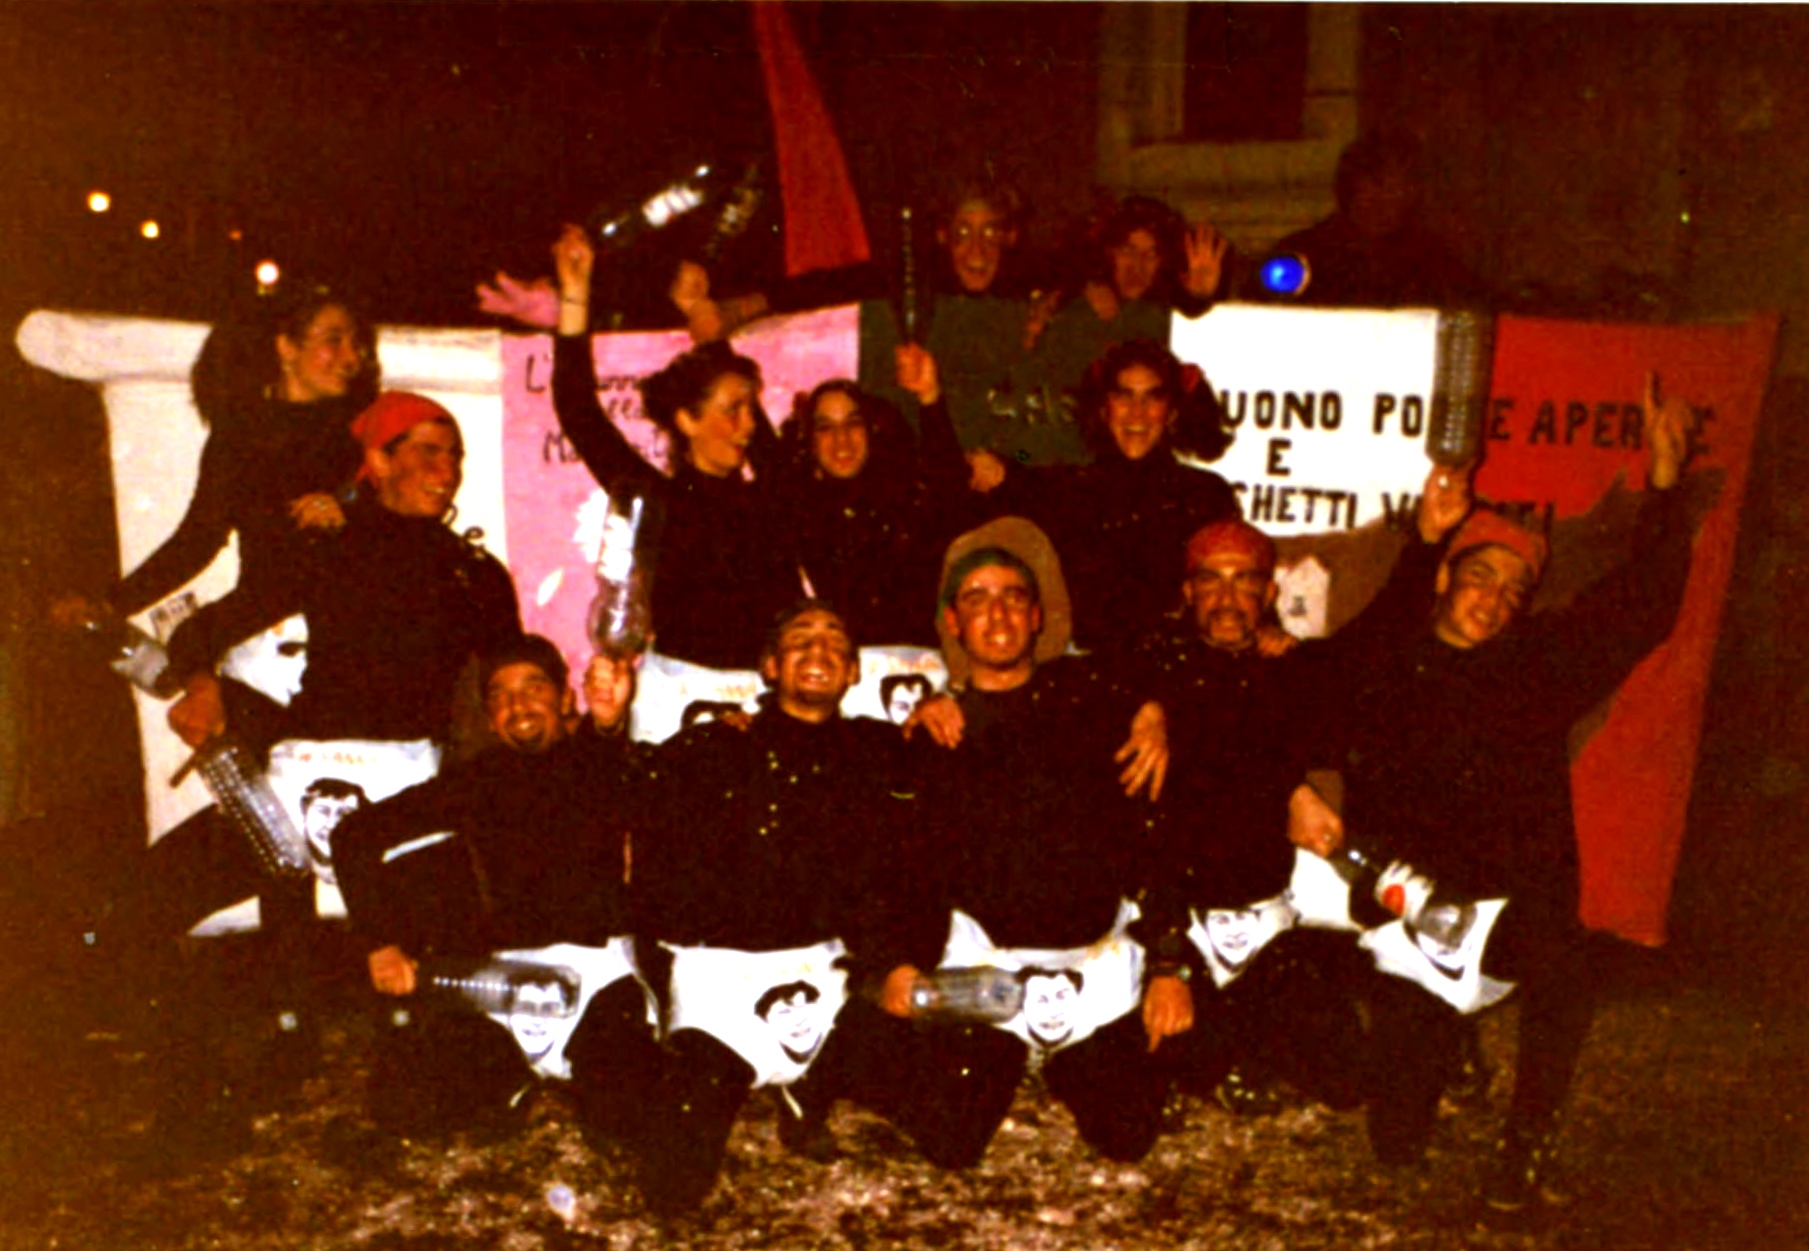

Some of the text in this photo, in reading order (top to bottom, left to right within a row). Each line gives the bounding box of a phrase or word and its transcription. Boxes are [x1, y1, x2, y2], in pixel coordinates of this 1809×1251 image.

[1219, 387, 1342, 432] UONO
[1527, 399, 1717, 455] APERE
[1265, 436, 1293, 478] E
